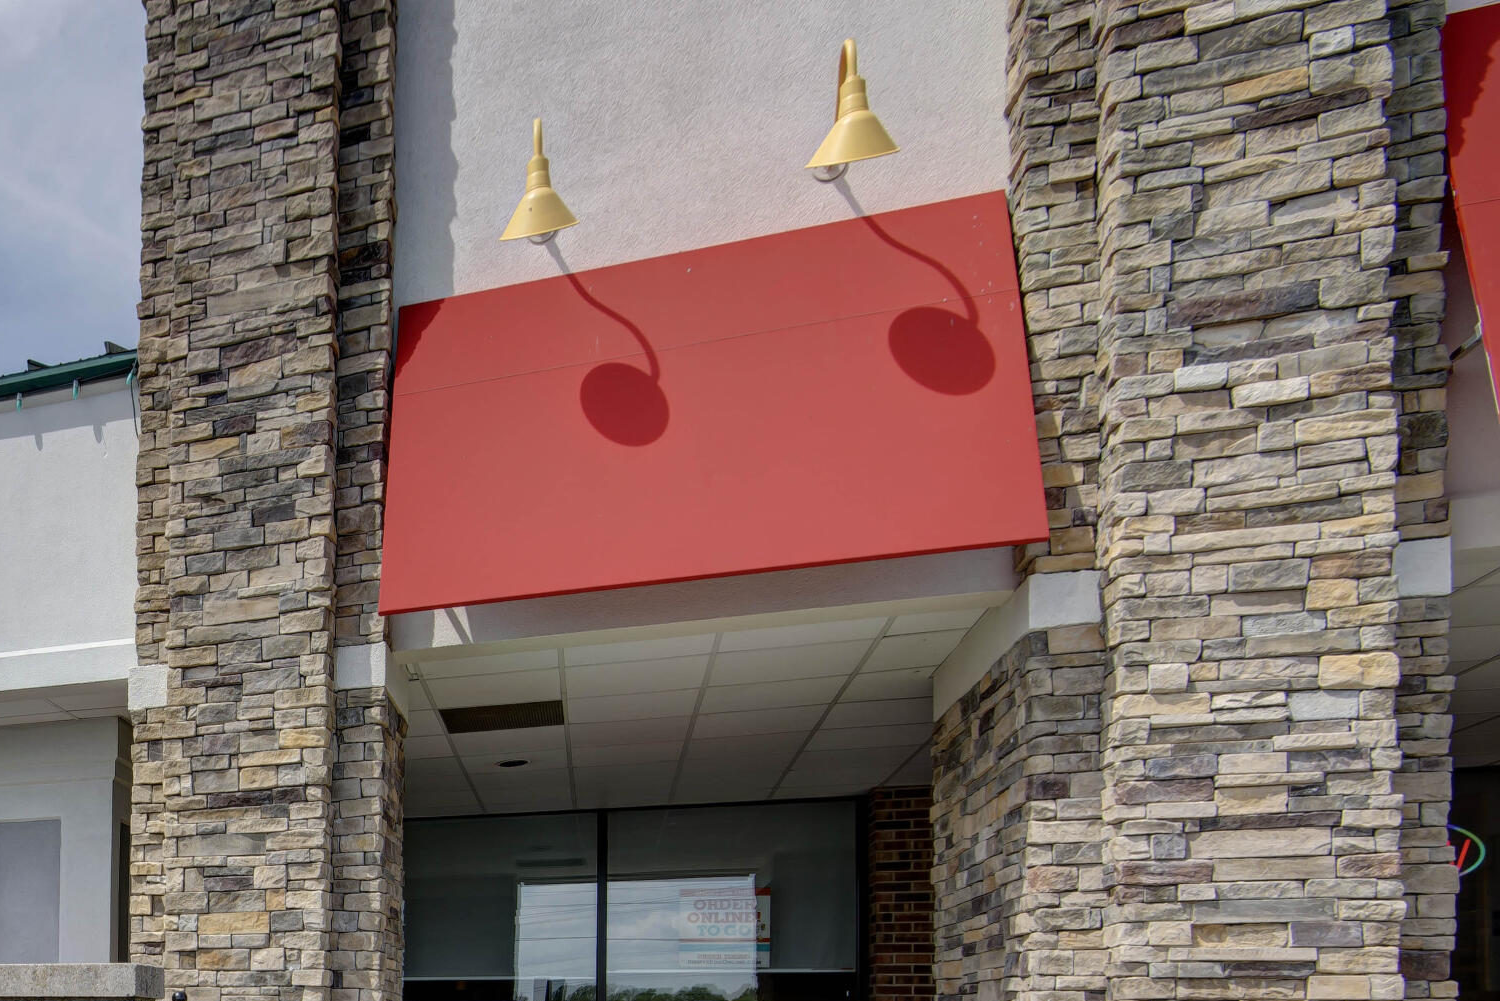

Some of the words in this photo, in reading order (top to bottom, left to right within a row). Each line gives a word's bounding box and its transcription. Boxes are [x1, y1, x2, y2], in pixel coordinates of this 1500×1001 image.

[693, 899, 757, 911] ORDER
[697, 925, 720, 937] TO
[724, 925, 752, 937] GO
